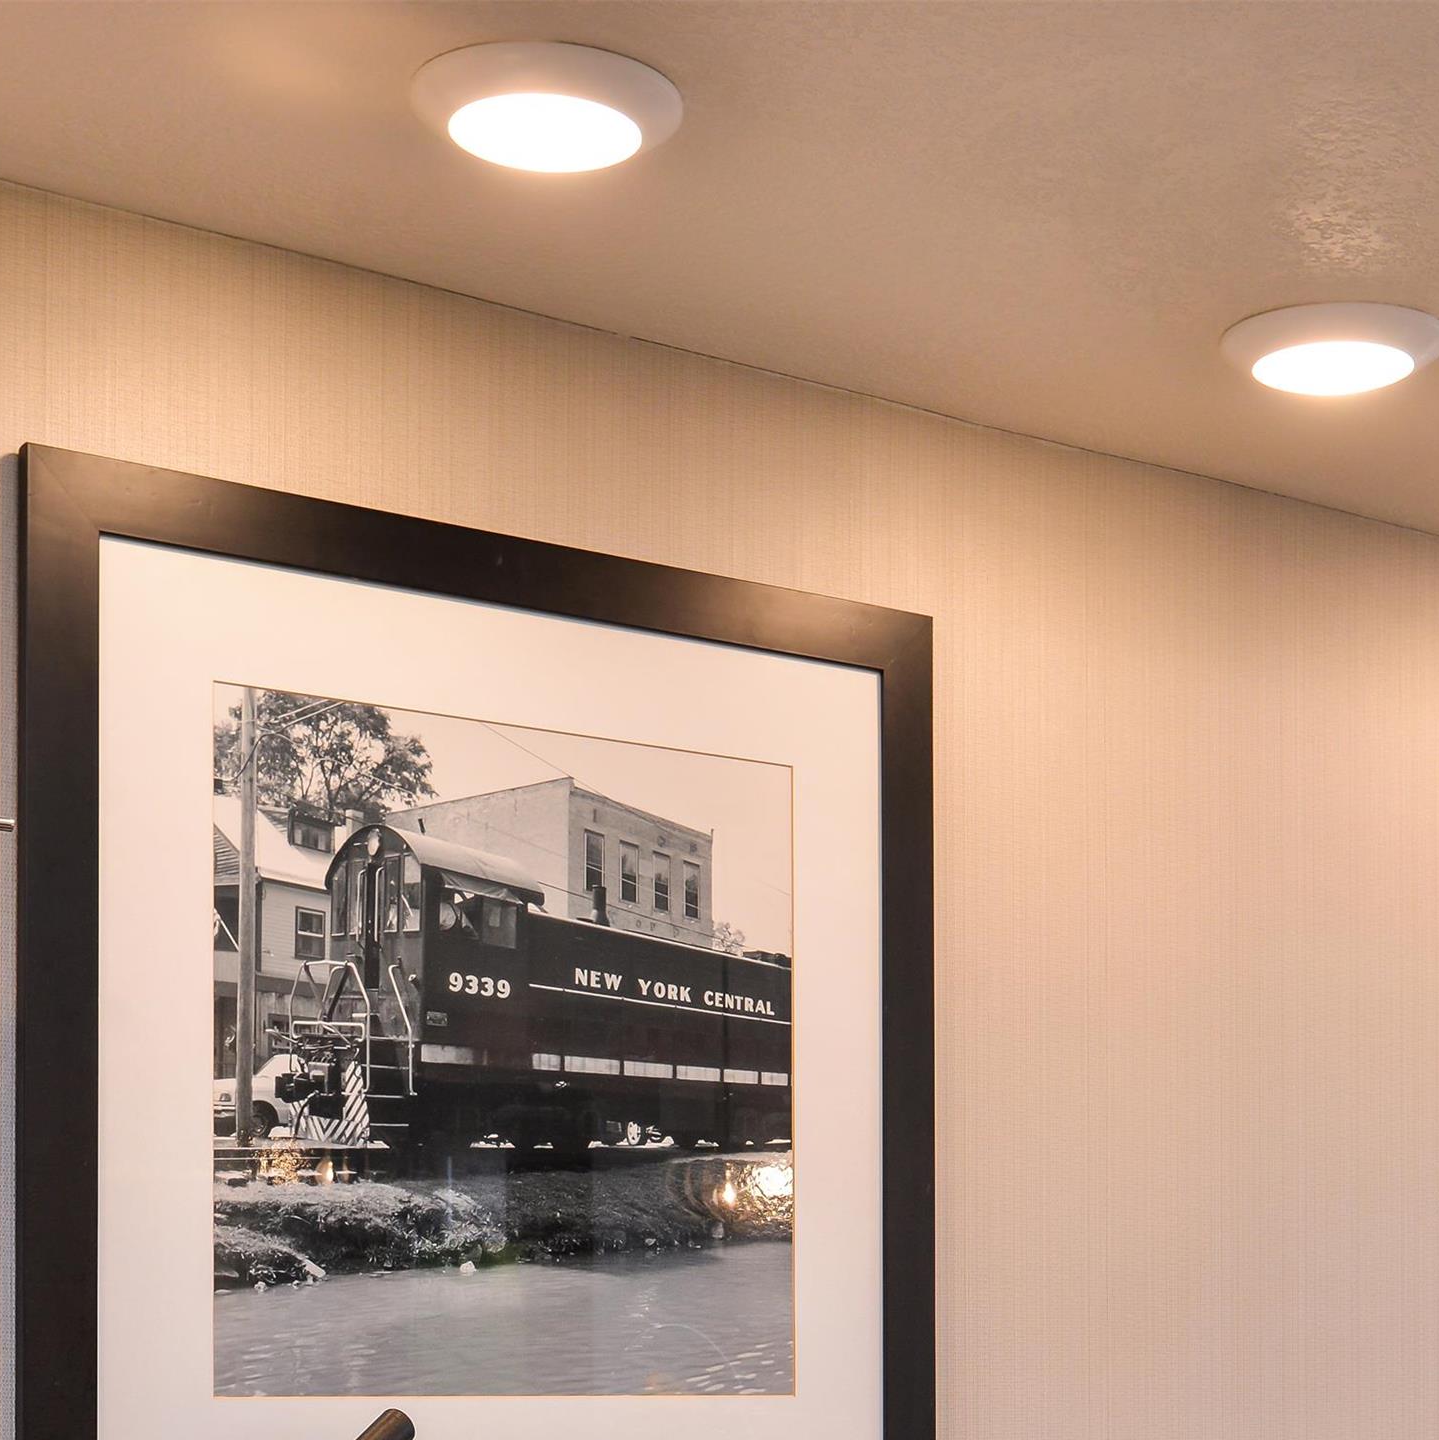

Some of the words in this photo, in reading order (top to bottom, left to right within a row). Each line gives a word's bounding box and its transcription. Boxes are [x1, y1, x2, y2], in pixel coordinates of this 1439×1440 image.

[448, 971, 512, 999] 9339
[574, 967, 623, 991] NEW
[637, 978, 692, 1003] YORK
[703, 990, 776, 1016] CENTRAL
